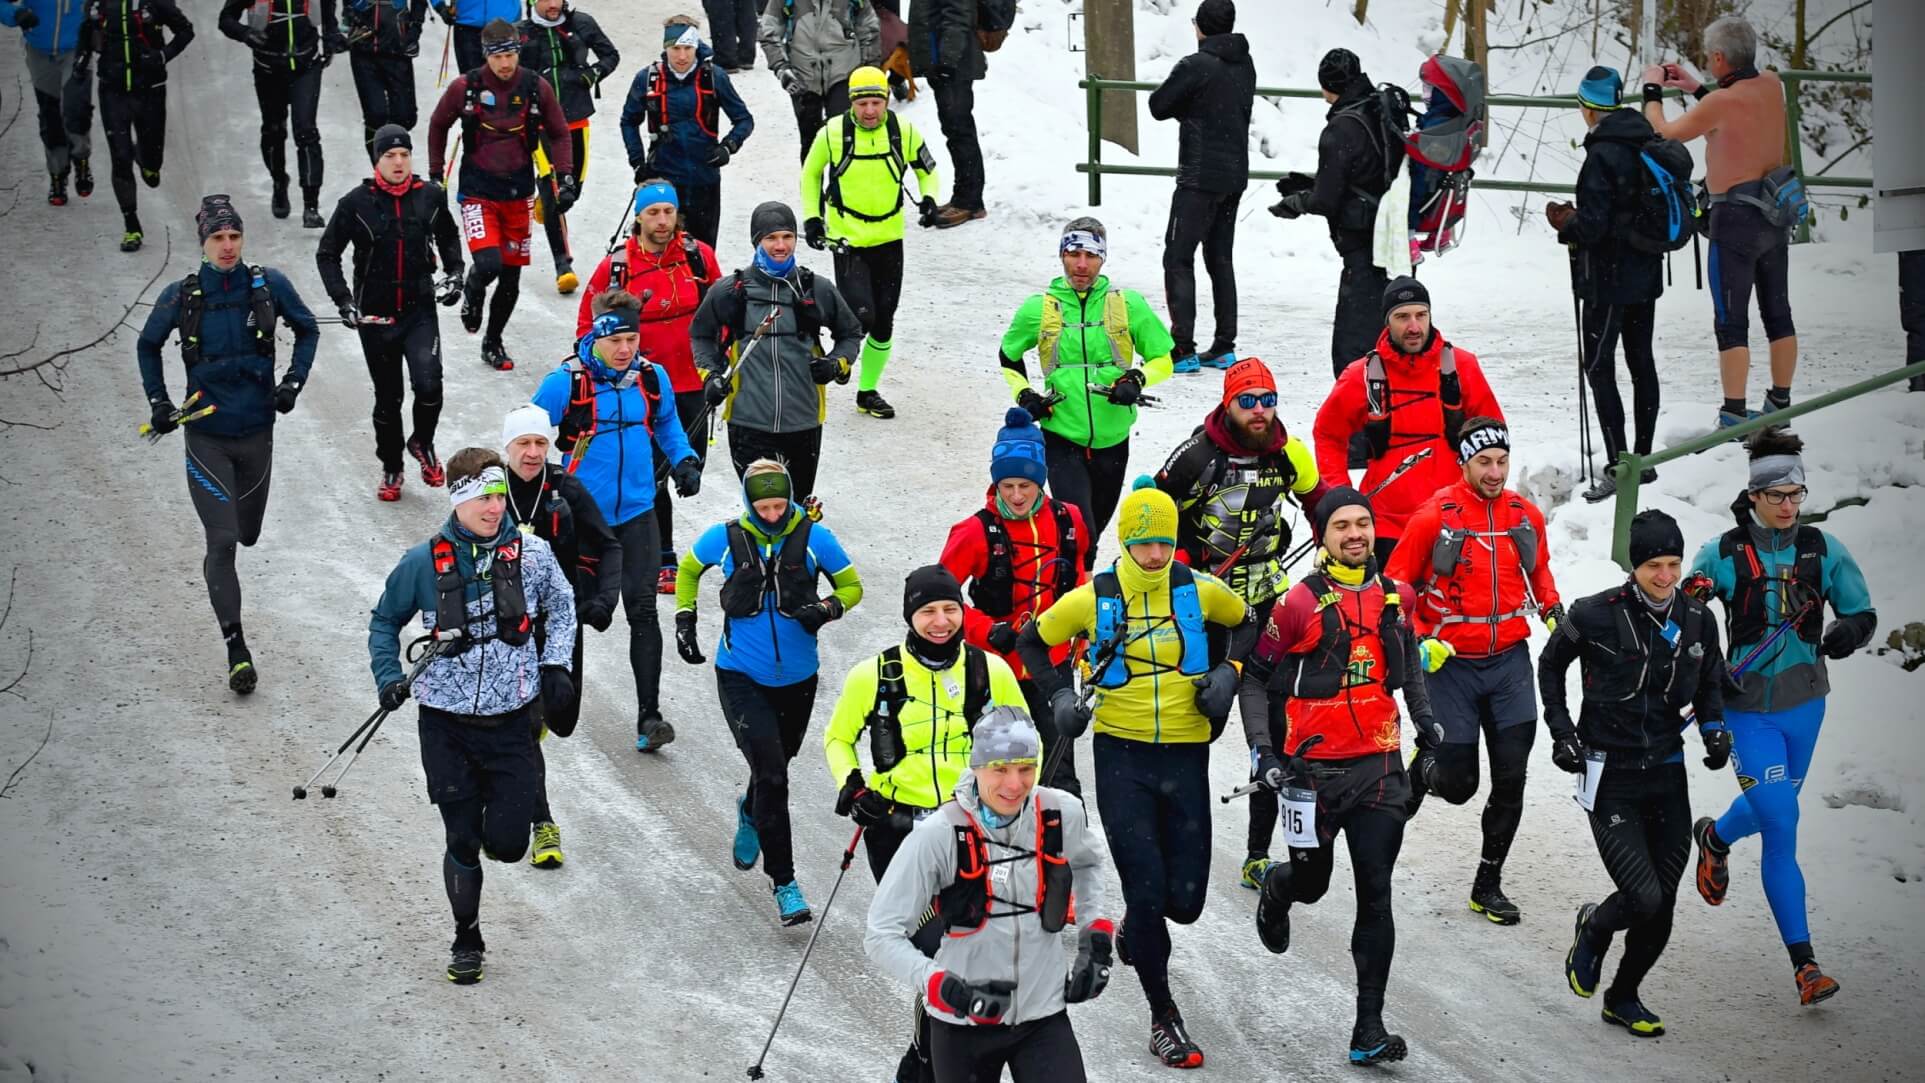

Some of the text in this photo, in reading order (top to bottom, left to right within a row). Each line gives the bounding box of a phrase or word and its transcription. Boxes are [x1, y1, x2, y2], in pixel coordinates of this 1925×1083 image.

[466, 203, 486, 240] SWEEP
[1460, 427, 1510, 460] ARM
[1281, 803, 1303, 835] 915
